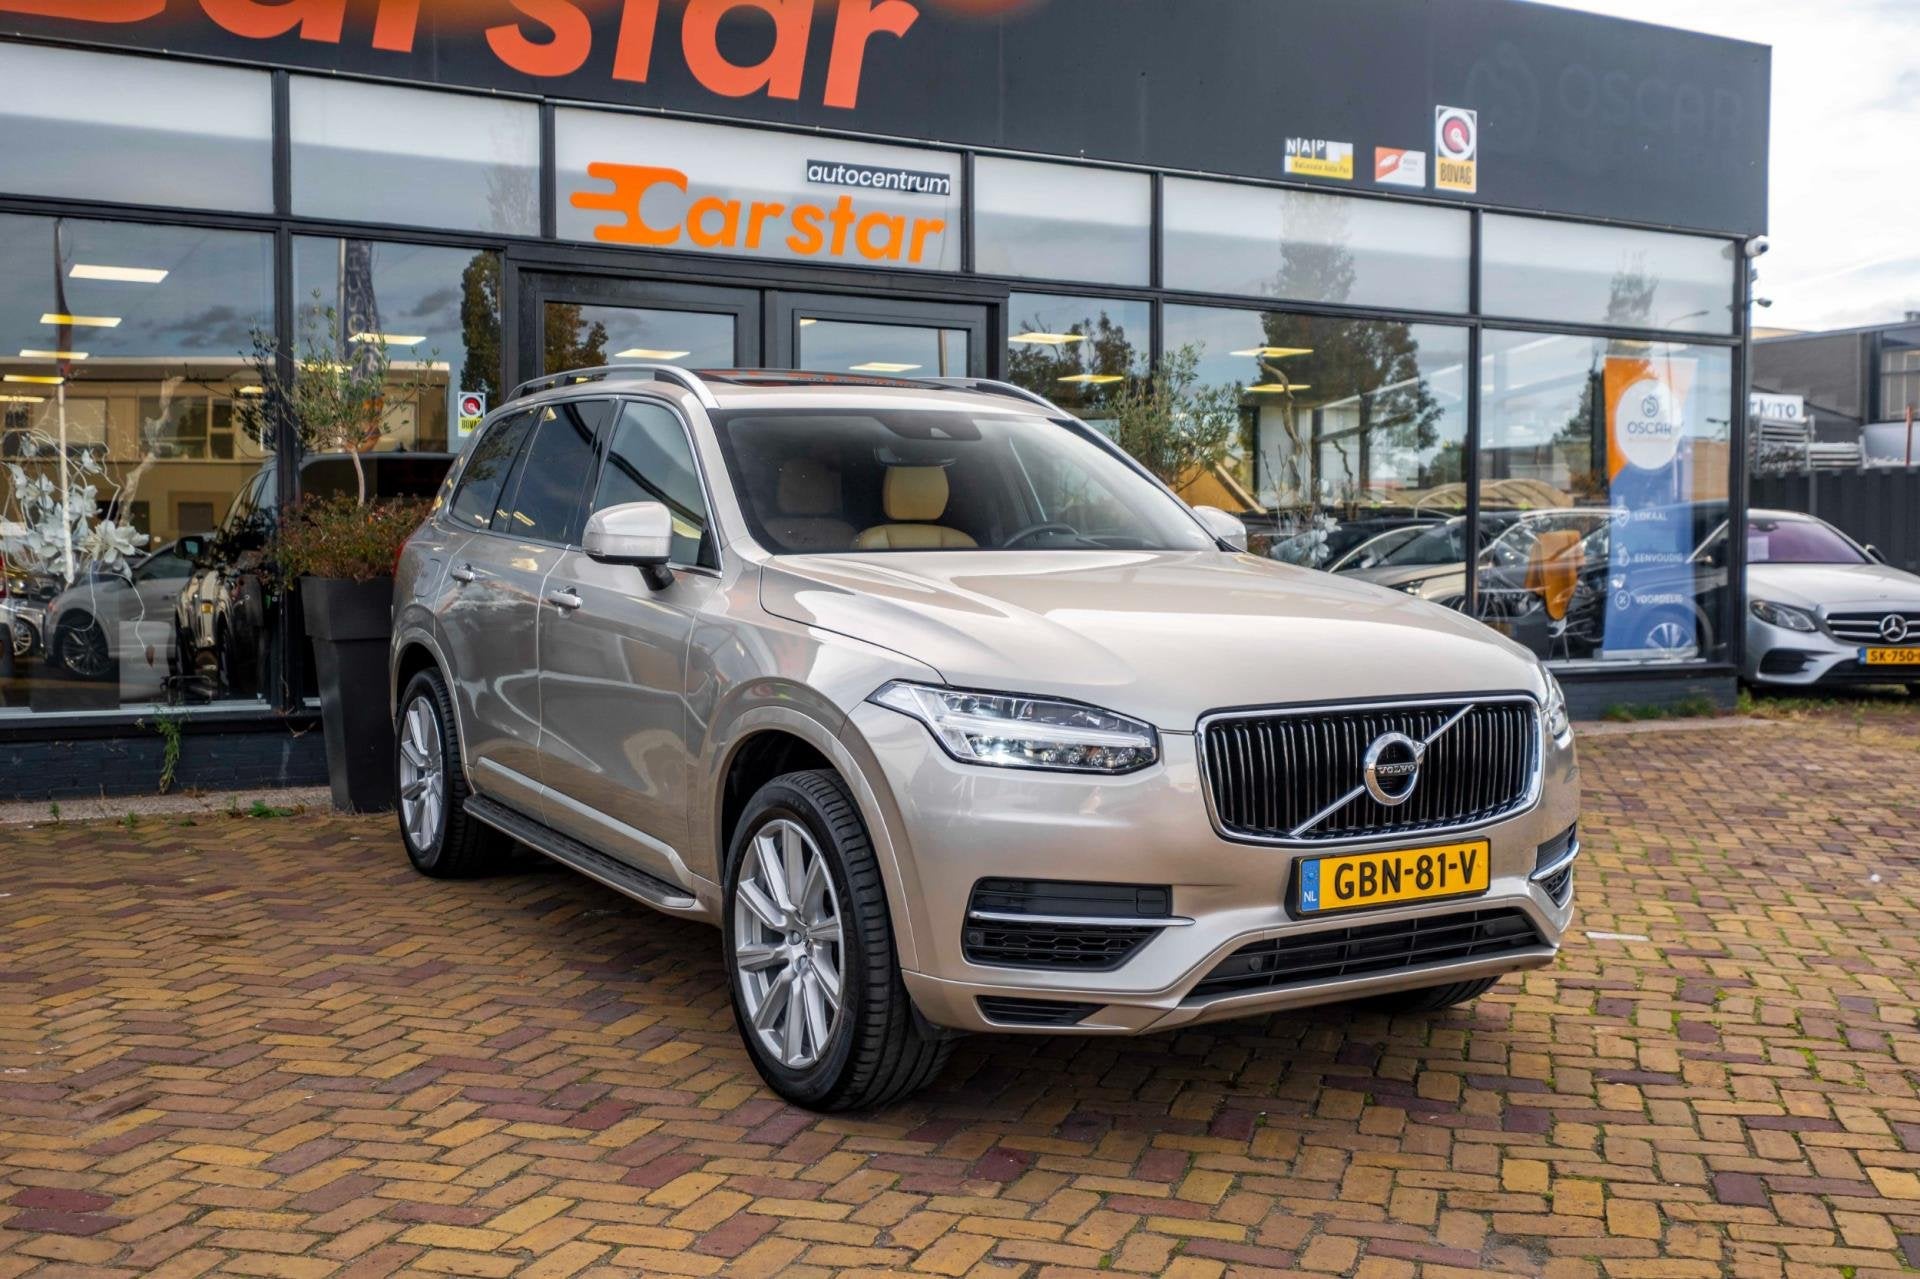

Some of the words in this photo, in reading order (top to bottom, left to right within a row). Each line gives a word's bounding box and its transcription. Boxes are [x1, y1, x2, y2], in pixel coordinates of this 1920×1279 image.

[808, 162, 950, 194] autocentrum
[1440, 163, 1472, 185] BOVAG
[569, 162, 946, 264] Carstar
[1634, 512, 1668, 521] LOKAAL
[1634, 552, 1683, 563] EENVOUDIG
[1871, 650, 1920, 661] SK-750-
[1377, 764, 1415, 774] VOLVO
[1304, 891, 1317, 902] NL
[1334, 849, 1478, 900] GBN-81-V
